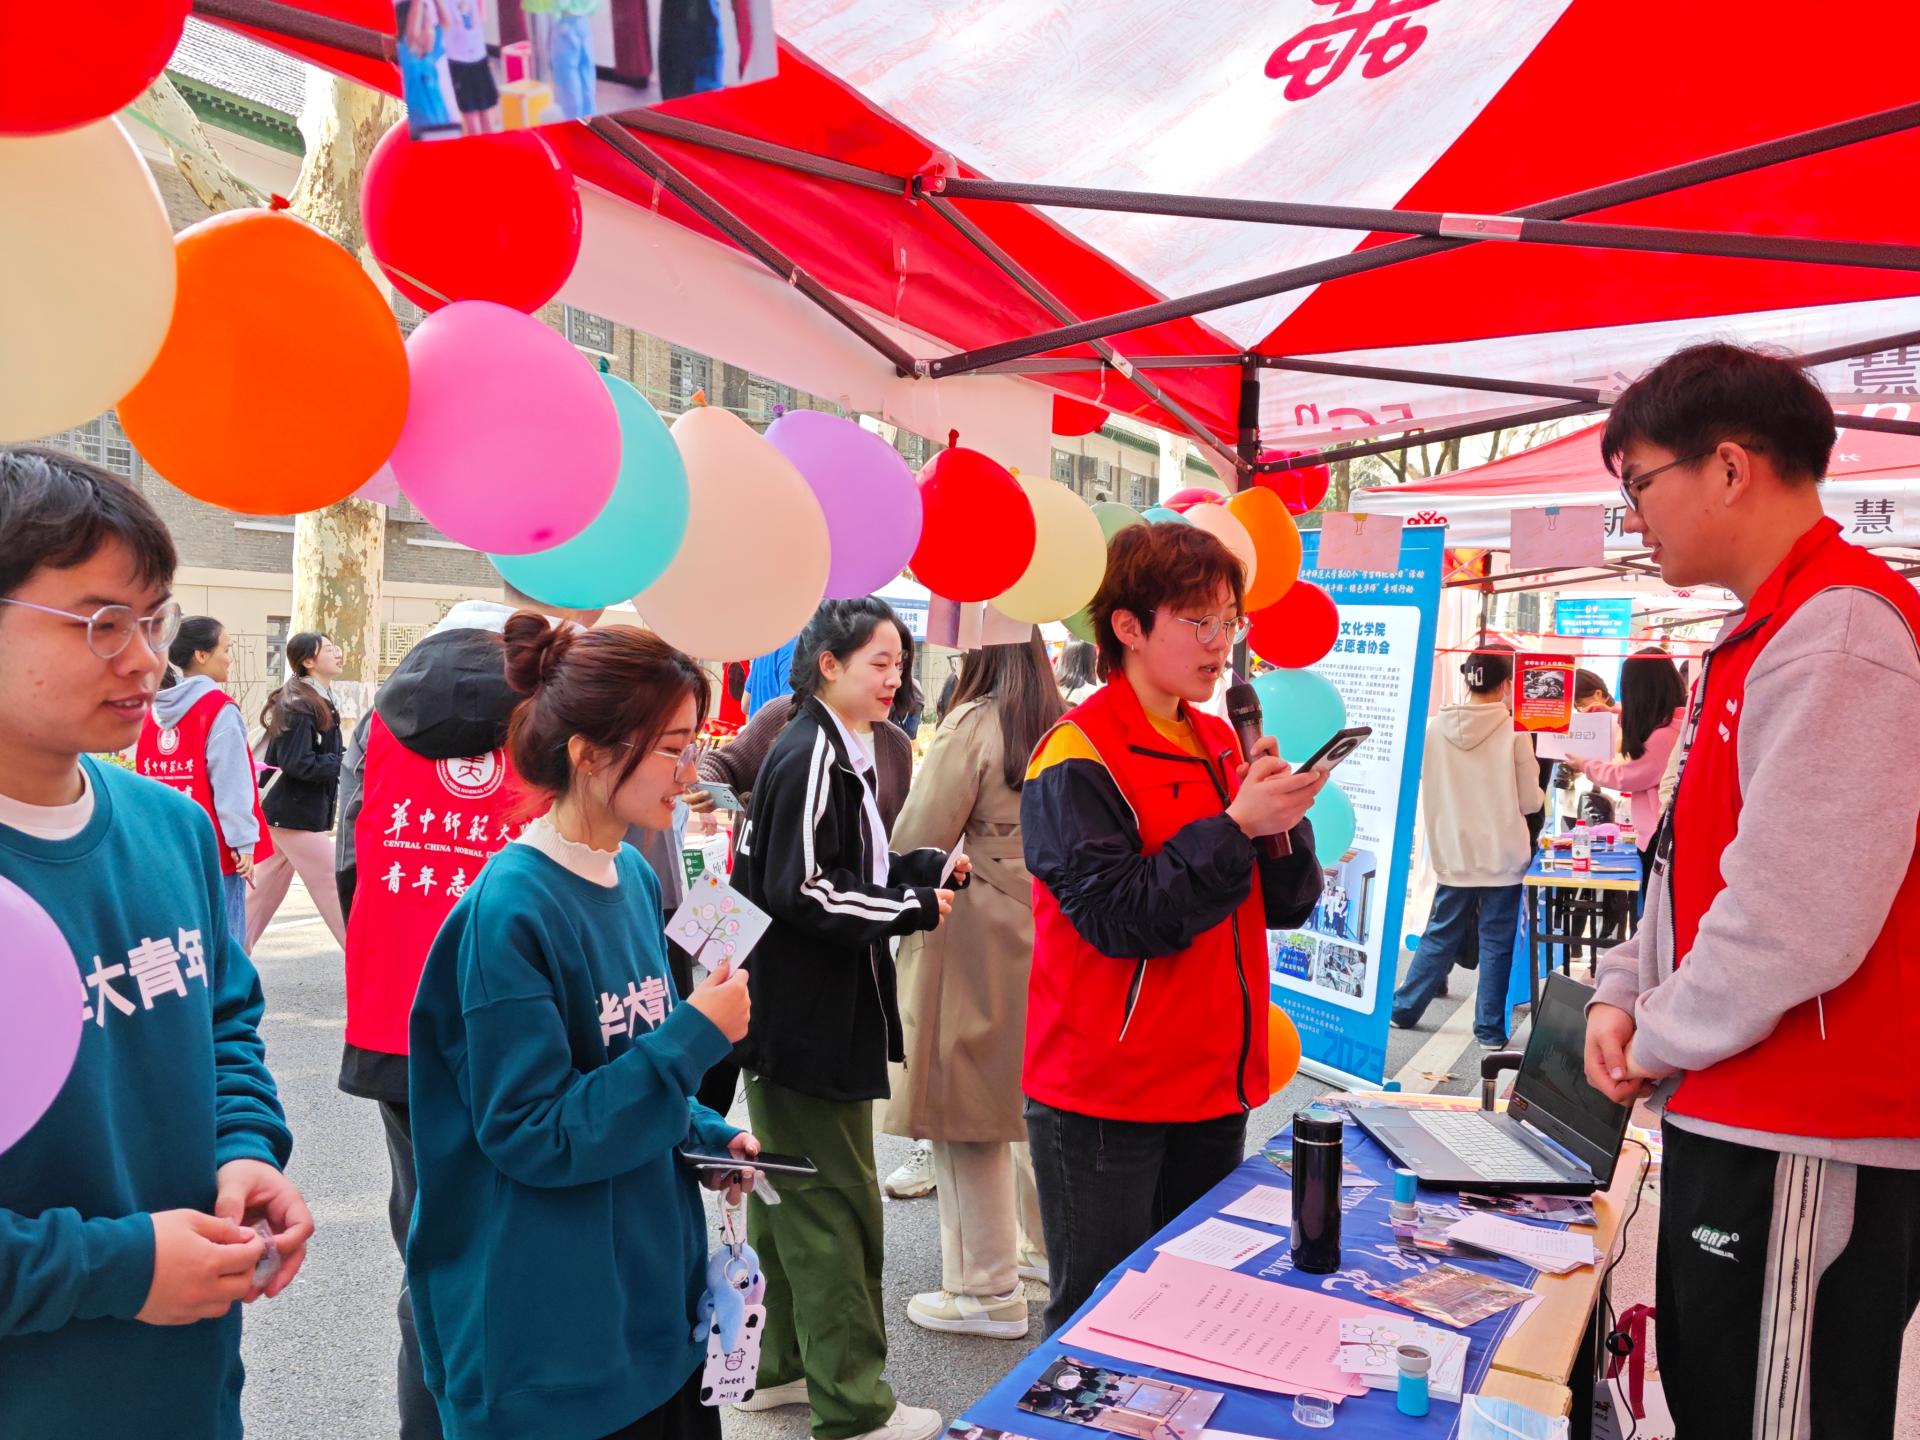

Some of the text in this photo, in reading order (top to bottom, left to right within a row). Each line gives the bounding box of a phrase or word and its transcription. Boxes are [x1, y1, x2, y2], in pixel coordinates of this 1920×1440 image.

[1851, 498, 1896, 535] 慧
[1340, 621, 1386, 636] 文化学院
[1333, 639, 1390, 654] 志愿者协会
[383, 840, 421, 850] CENTRAL
[424, 842, 451, 853] CHINA
[454, 845, 484, 858] NORMAL
[83, 927, 208, 1029] 大青年
[598, 973, 673, 1047] 华大青
